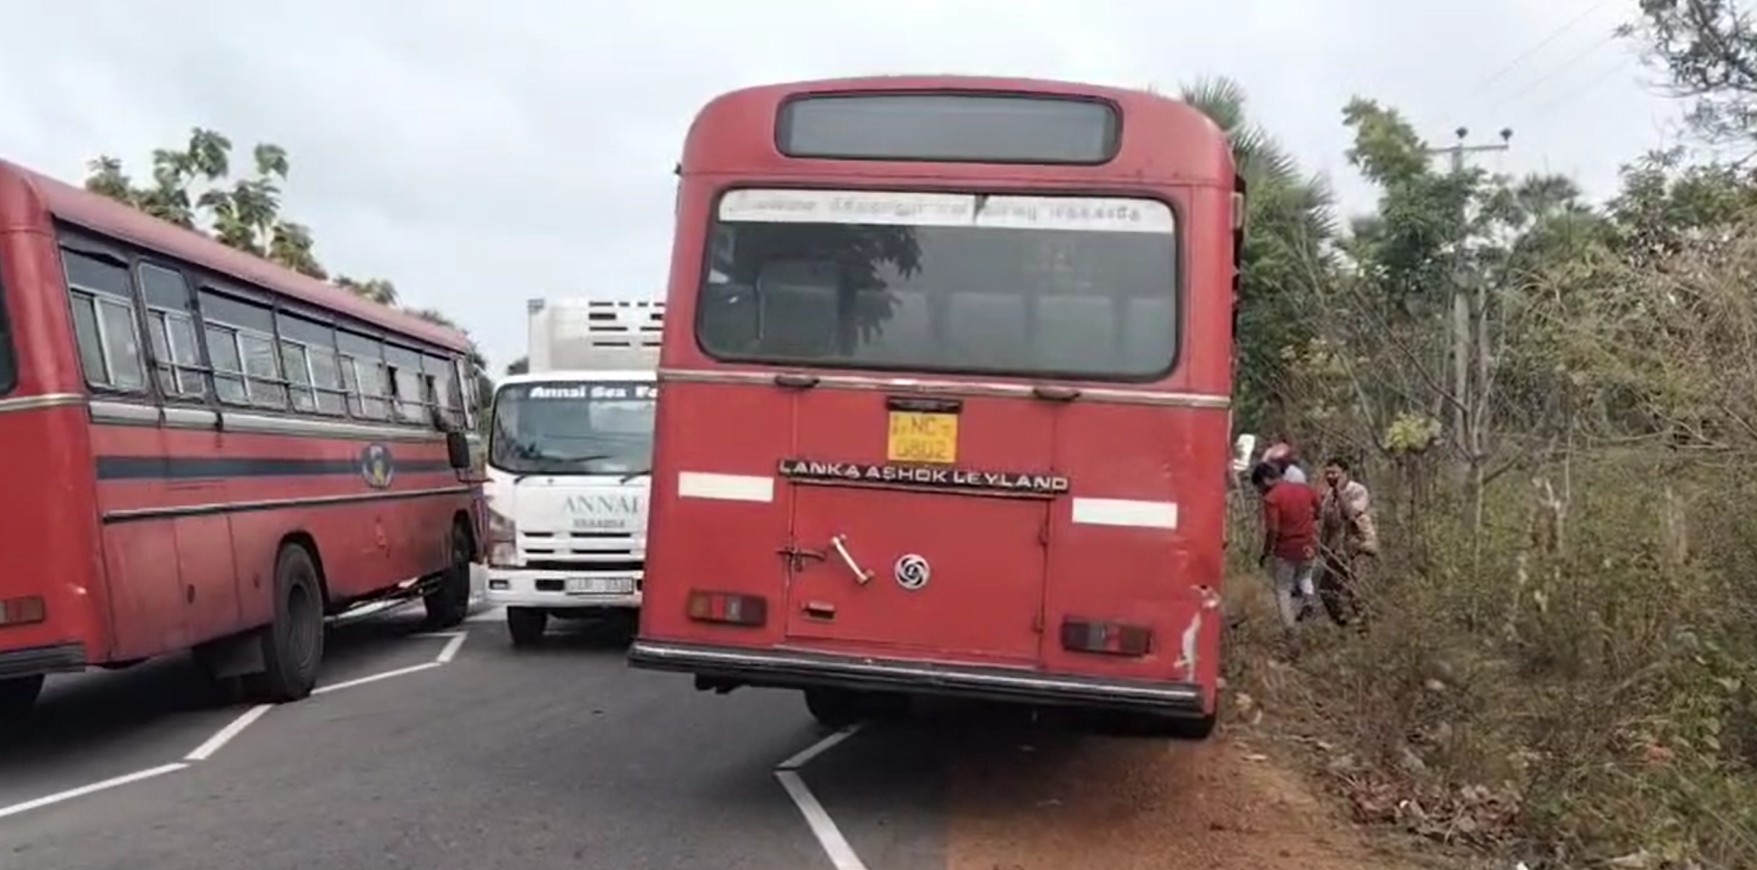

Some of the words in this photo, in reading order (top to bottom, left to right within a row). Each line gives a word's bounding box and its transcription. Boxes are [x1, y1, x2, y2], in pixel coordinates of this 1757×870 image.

[530, 386, 586, 398] Annai
[911, 416, 938, 436] NC
[779, 459, 861, 479] LANKA
[865, 466, 947, 483] ASHOK
[953, 470, 1068, 491] LEYLAND
